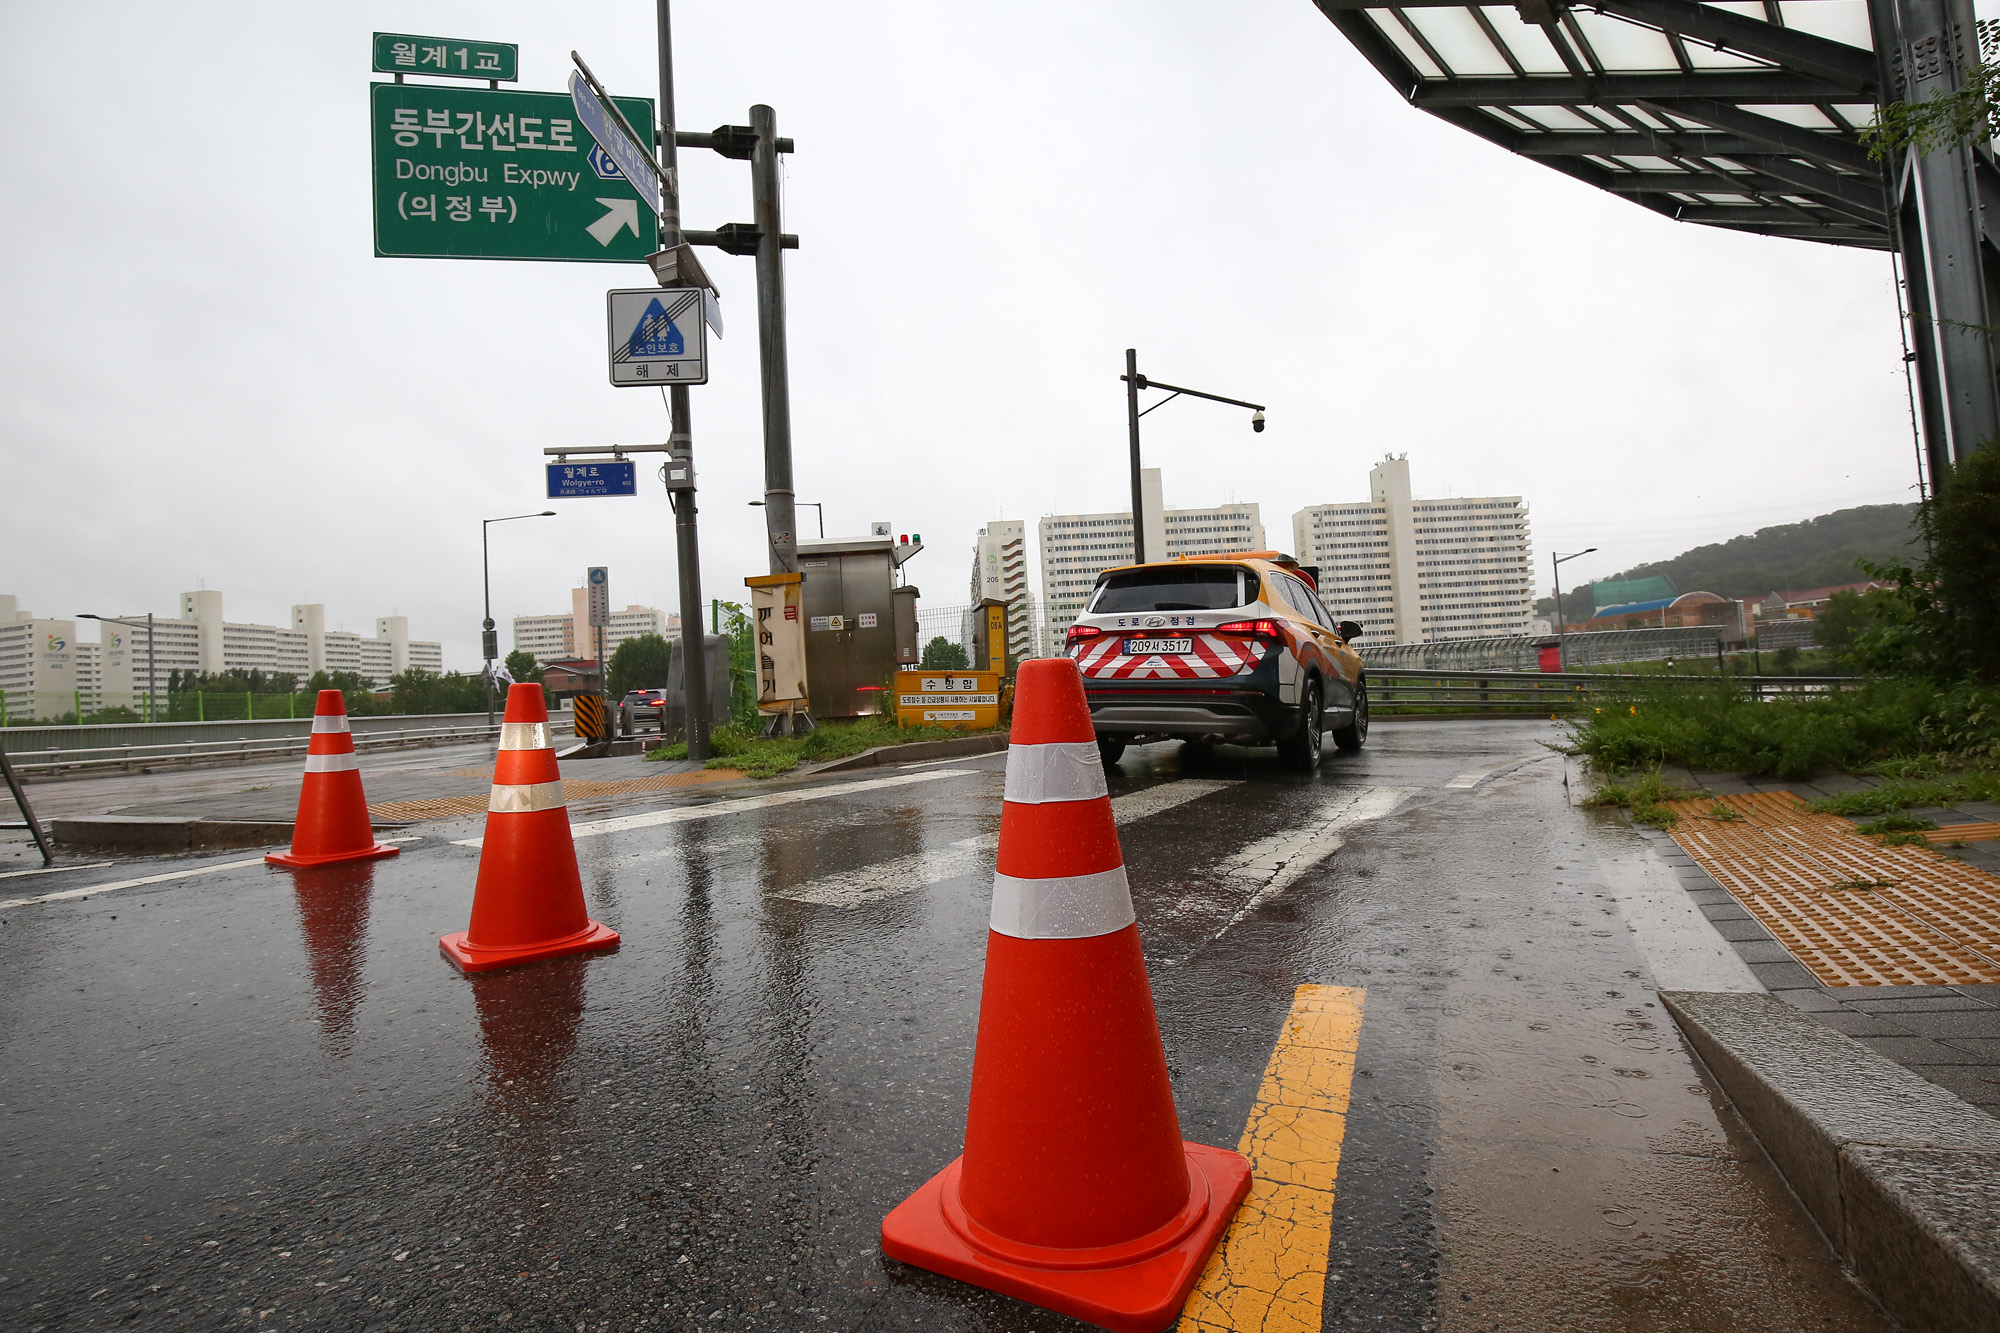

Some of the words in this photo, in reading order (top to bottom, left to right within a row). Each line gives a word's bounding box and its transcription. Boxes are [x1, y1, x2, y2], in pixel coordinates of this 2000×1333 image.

[389, 41, 502, 72] 월계1교
[390, 107, 578, 153] 동부간선도로
[602, 112, 656, 194] 한글비석로
[395, 158, 489, 187] Dongbu
[503, 162, 581, 191] Expwy
[397, 190, 518, 224] (의정부)
[634, 342, 679, 355] 노인보호
[563, 466, 600, 479] 월계로
[561, 479, 605, 488] Wolgye-ro
[1118, 617, 1140, 627] 도로
[1170, 616, 1195, 626] 점검
[1131, 640, 1160, 652] 209서
[1162, 640, 1189, 652] 3517
[926, 678, 973, 690] 수방함
[950, 695, 968, 703] 사용하는
